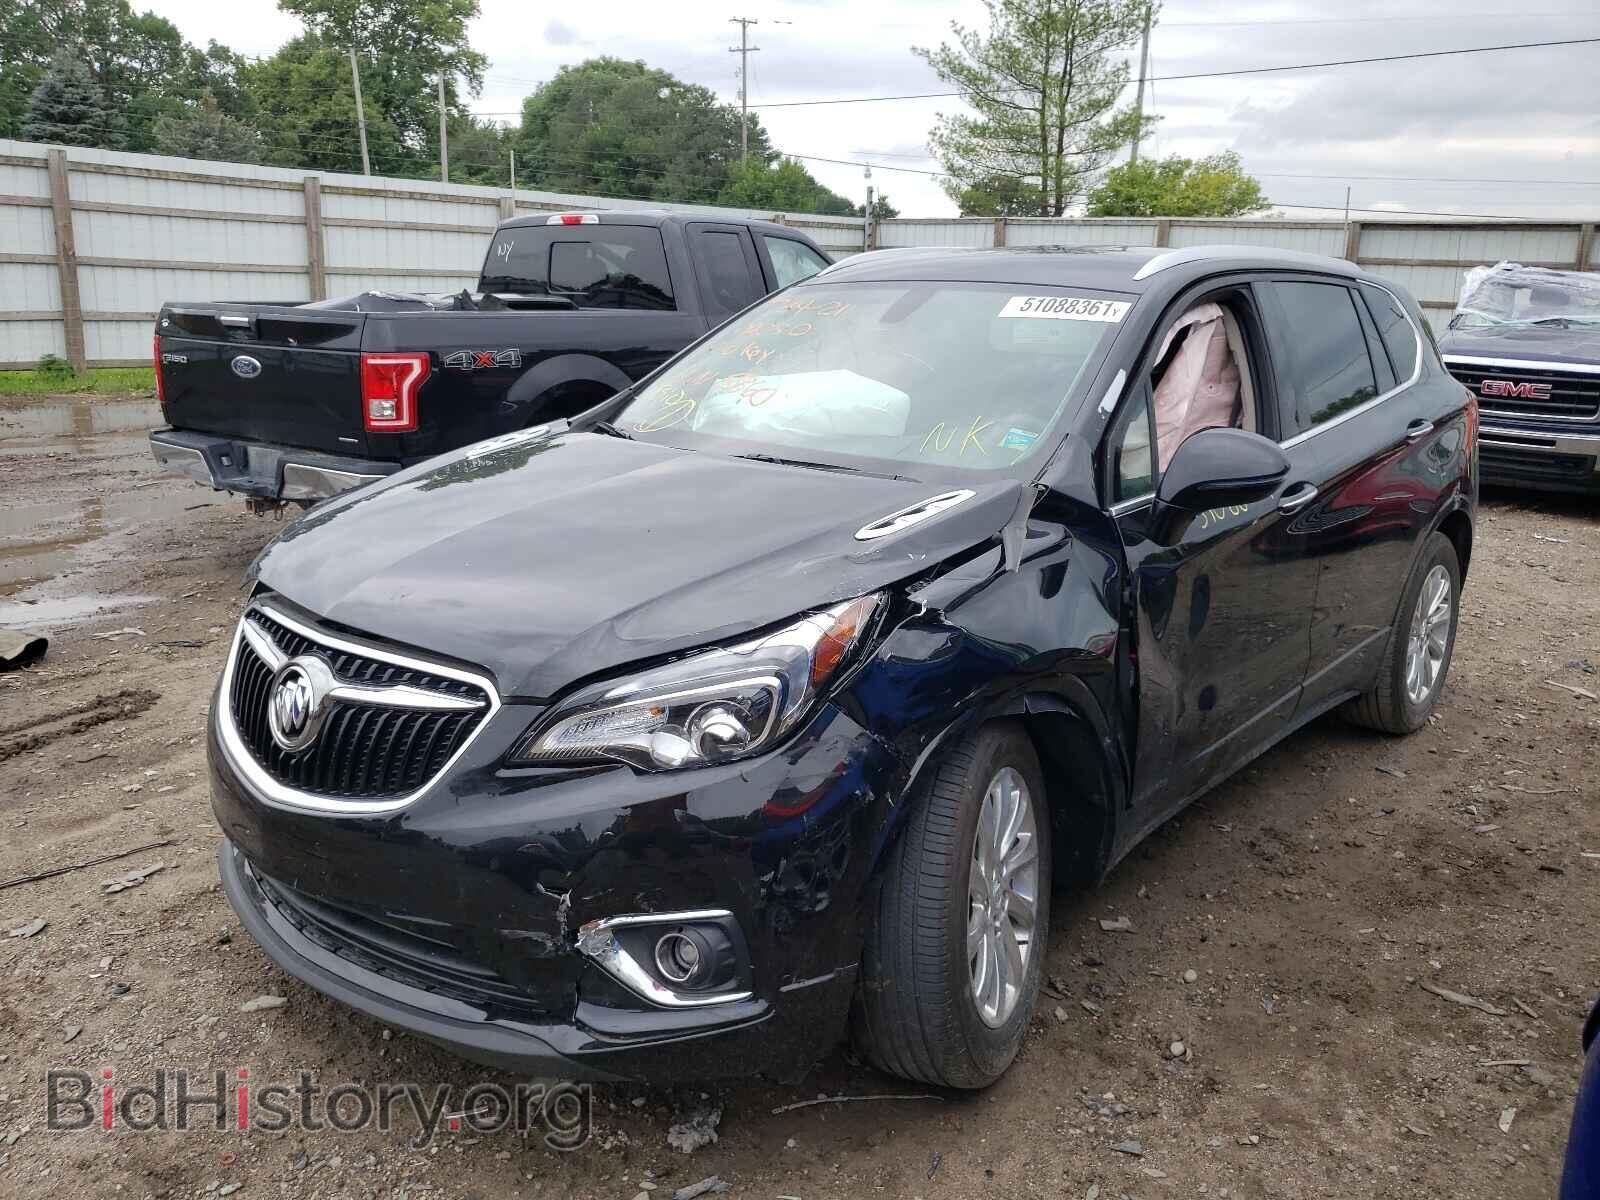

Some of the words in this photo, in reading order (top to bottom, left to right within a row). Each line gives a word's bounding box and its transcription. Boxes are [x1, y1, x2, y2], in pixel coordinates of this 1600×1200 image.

[497, 241, 514, 263] NY
[1020, 297, 1113, 317] 51088361
[1481, 380, 1552, 399] GMC
